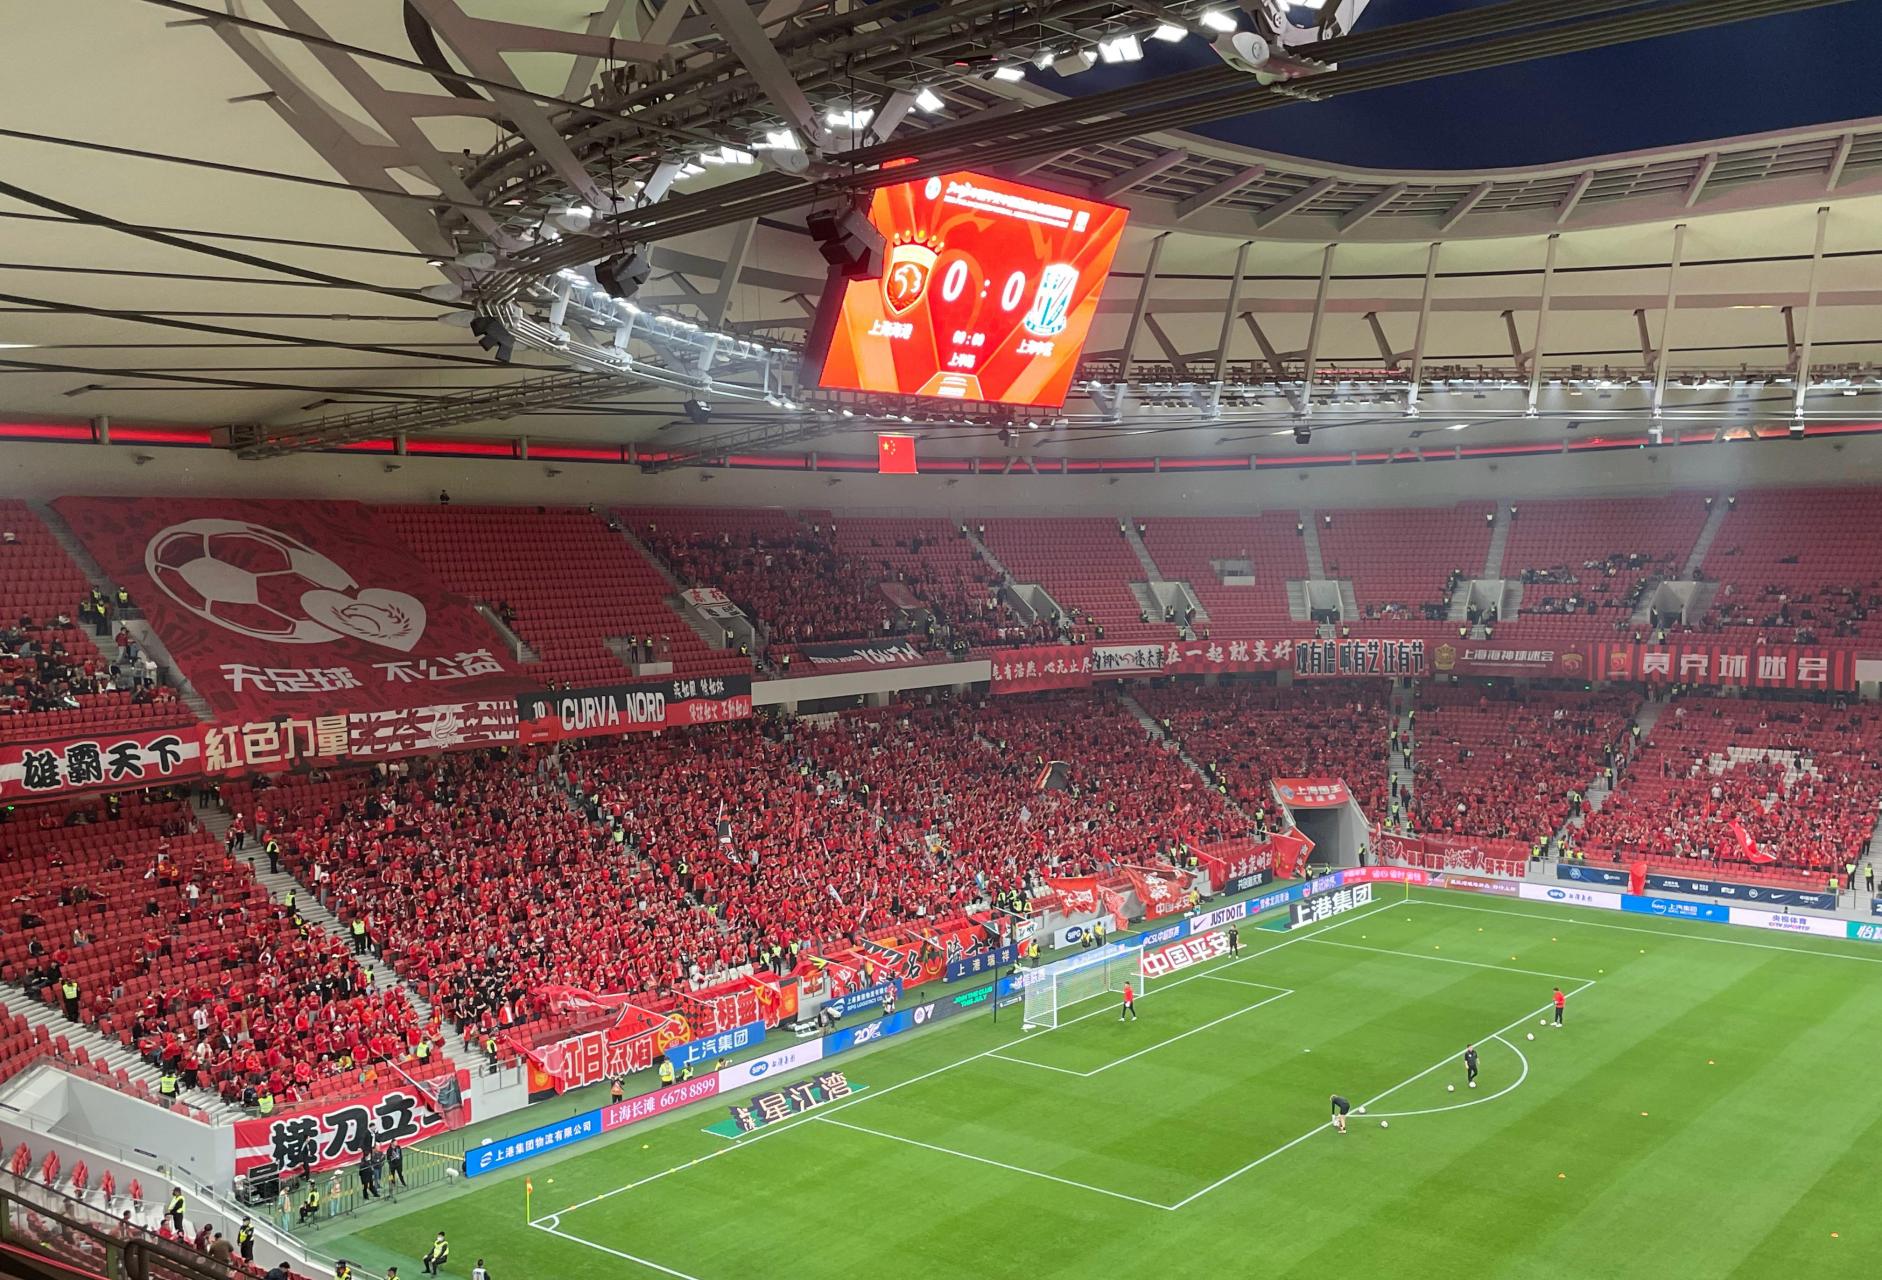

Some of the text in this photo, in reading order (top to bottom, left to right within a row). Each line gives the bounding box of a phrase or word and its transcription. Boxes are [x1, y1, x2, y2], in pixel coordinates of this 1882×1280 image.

[942, 259, 968, 302] 0
[1001, 271, 1026, 311] 0
[220, 648, 506, 693] 无足球 不公益
[1165, 639, 1293, 665] 在一起就美好
[561, 691, 666, 731] CURVA NORD
[21, 735, 183, 790] 雄霸天下
[204, 714, 350, 772] 紅色力量
[1210, 911, 1225, 927] JUST
[1225, 907, 1236, 921] DO
[1291, 882, 1372, 930] 上港集团
[1067, 930, 1082, 939] SIPG
[1142, 931, 1229, 976] 中国平安
[683, 1029, 749, 1064] 上汽集团
[751, 1063, 768, 1076] SIPG
[606, 1078, 716, 1126] 上海长滩 6678 8899
[759, 1071, 853, 1125] 星江湾
[270, 1092, 443, 1172] 横刀立
[495, 1120, 592, 1162] 上港集团物流有限公司
